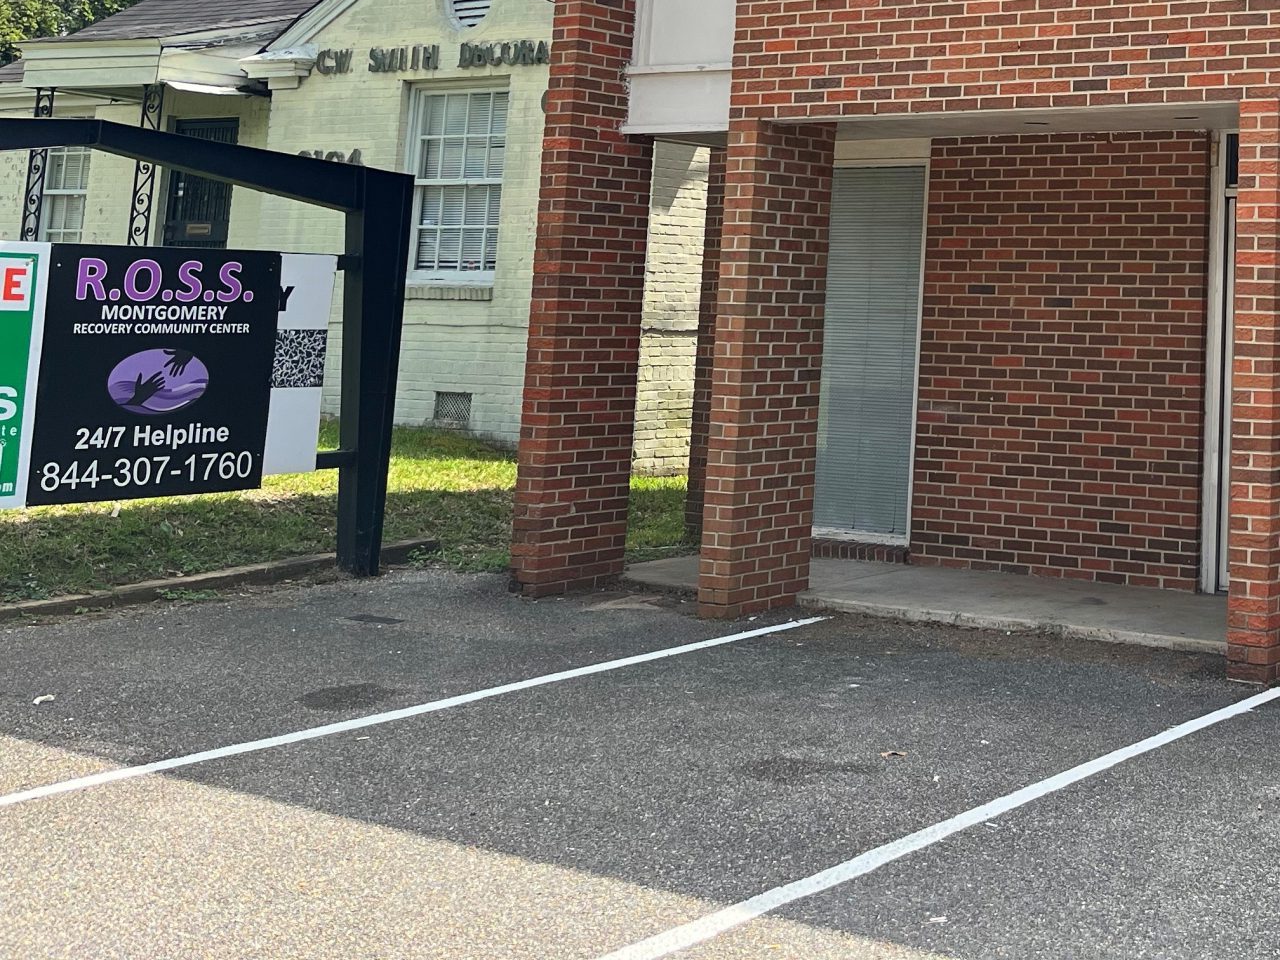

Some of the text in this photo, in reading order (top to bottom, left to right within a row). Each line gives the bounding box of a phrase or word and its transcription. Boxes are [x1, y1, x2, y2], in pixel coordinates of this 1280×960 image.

[368, 44, 440, 72] SMITH
[75, 257, 254, 303] R.O.S.S.
[101, 305, 228, 321] MONTGOMERY
[73, 323, 250, 335] RECOVERY COMMUNITY CENTER
[75, 423, 229, 450] 24/7 Helpline
[40, 450, 253, 492] 844-307-1760
